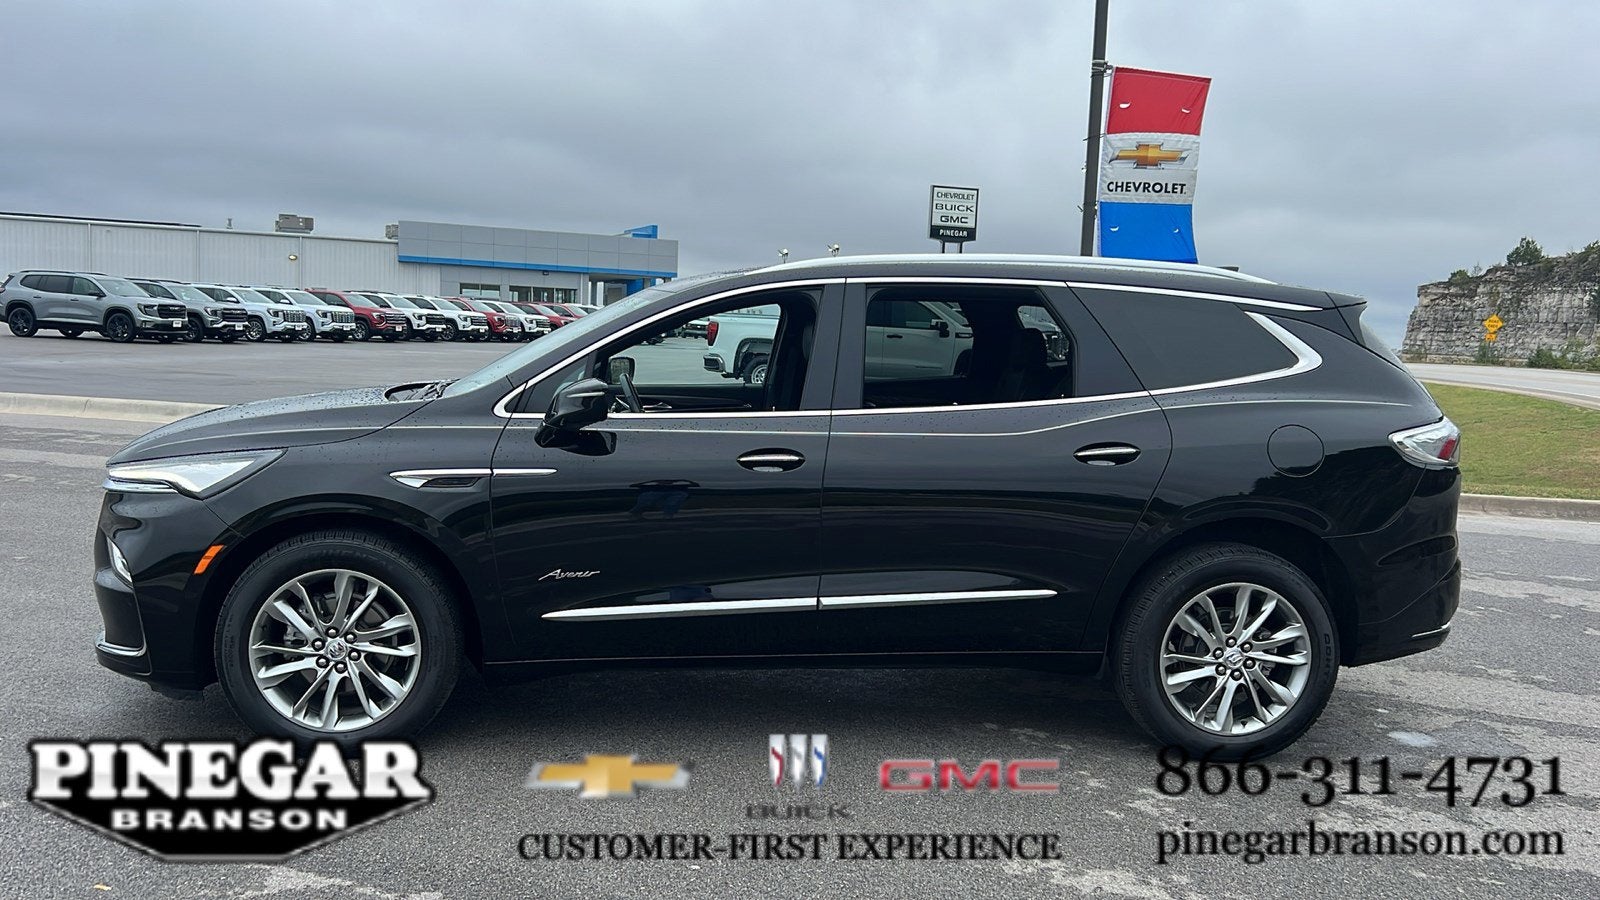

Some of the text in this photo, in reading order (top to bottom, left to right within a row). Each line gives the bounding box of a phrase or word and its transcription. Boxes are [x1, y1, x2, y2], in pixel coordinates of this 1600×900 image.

[936, 191, 975, 201] CHEVROLET
[935, 202, 974, 213] BUICK
[940, 215, 969, 224] GMC
[939, 229, 968, 237] PINEGAR
